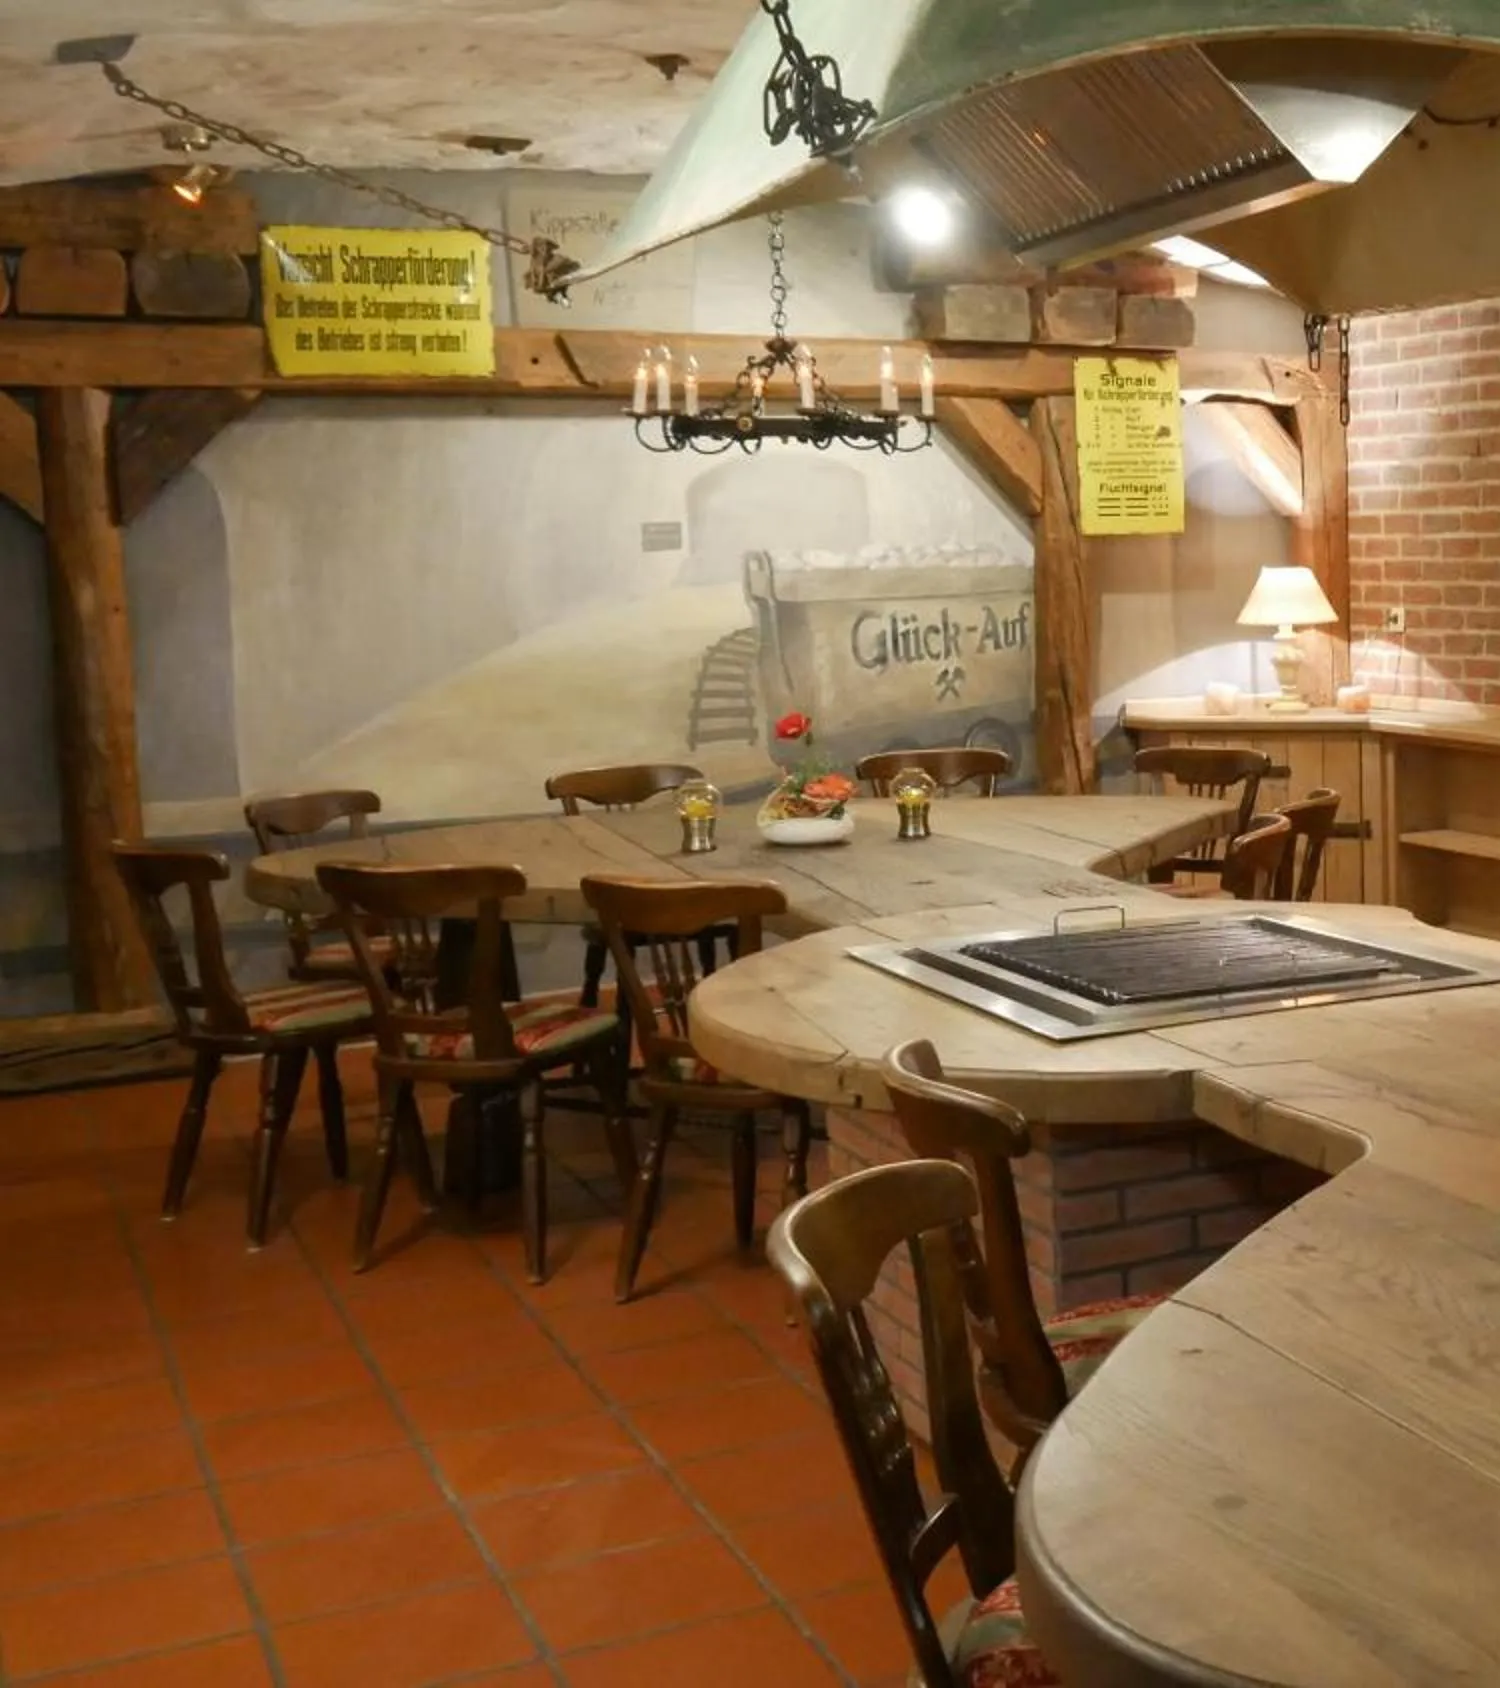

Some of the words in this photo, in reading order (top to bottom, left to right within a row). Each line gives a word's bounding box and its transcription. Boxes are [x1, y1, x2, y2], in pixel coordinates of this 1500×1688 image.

[339, 244, 476, 294] Schrapperförderung!
[1100, 373, 1157, 388] Signale
[851, 601, 1031, 673] Glück-Auf
